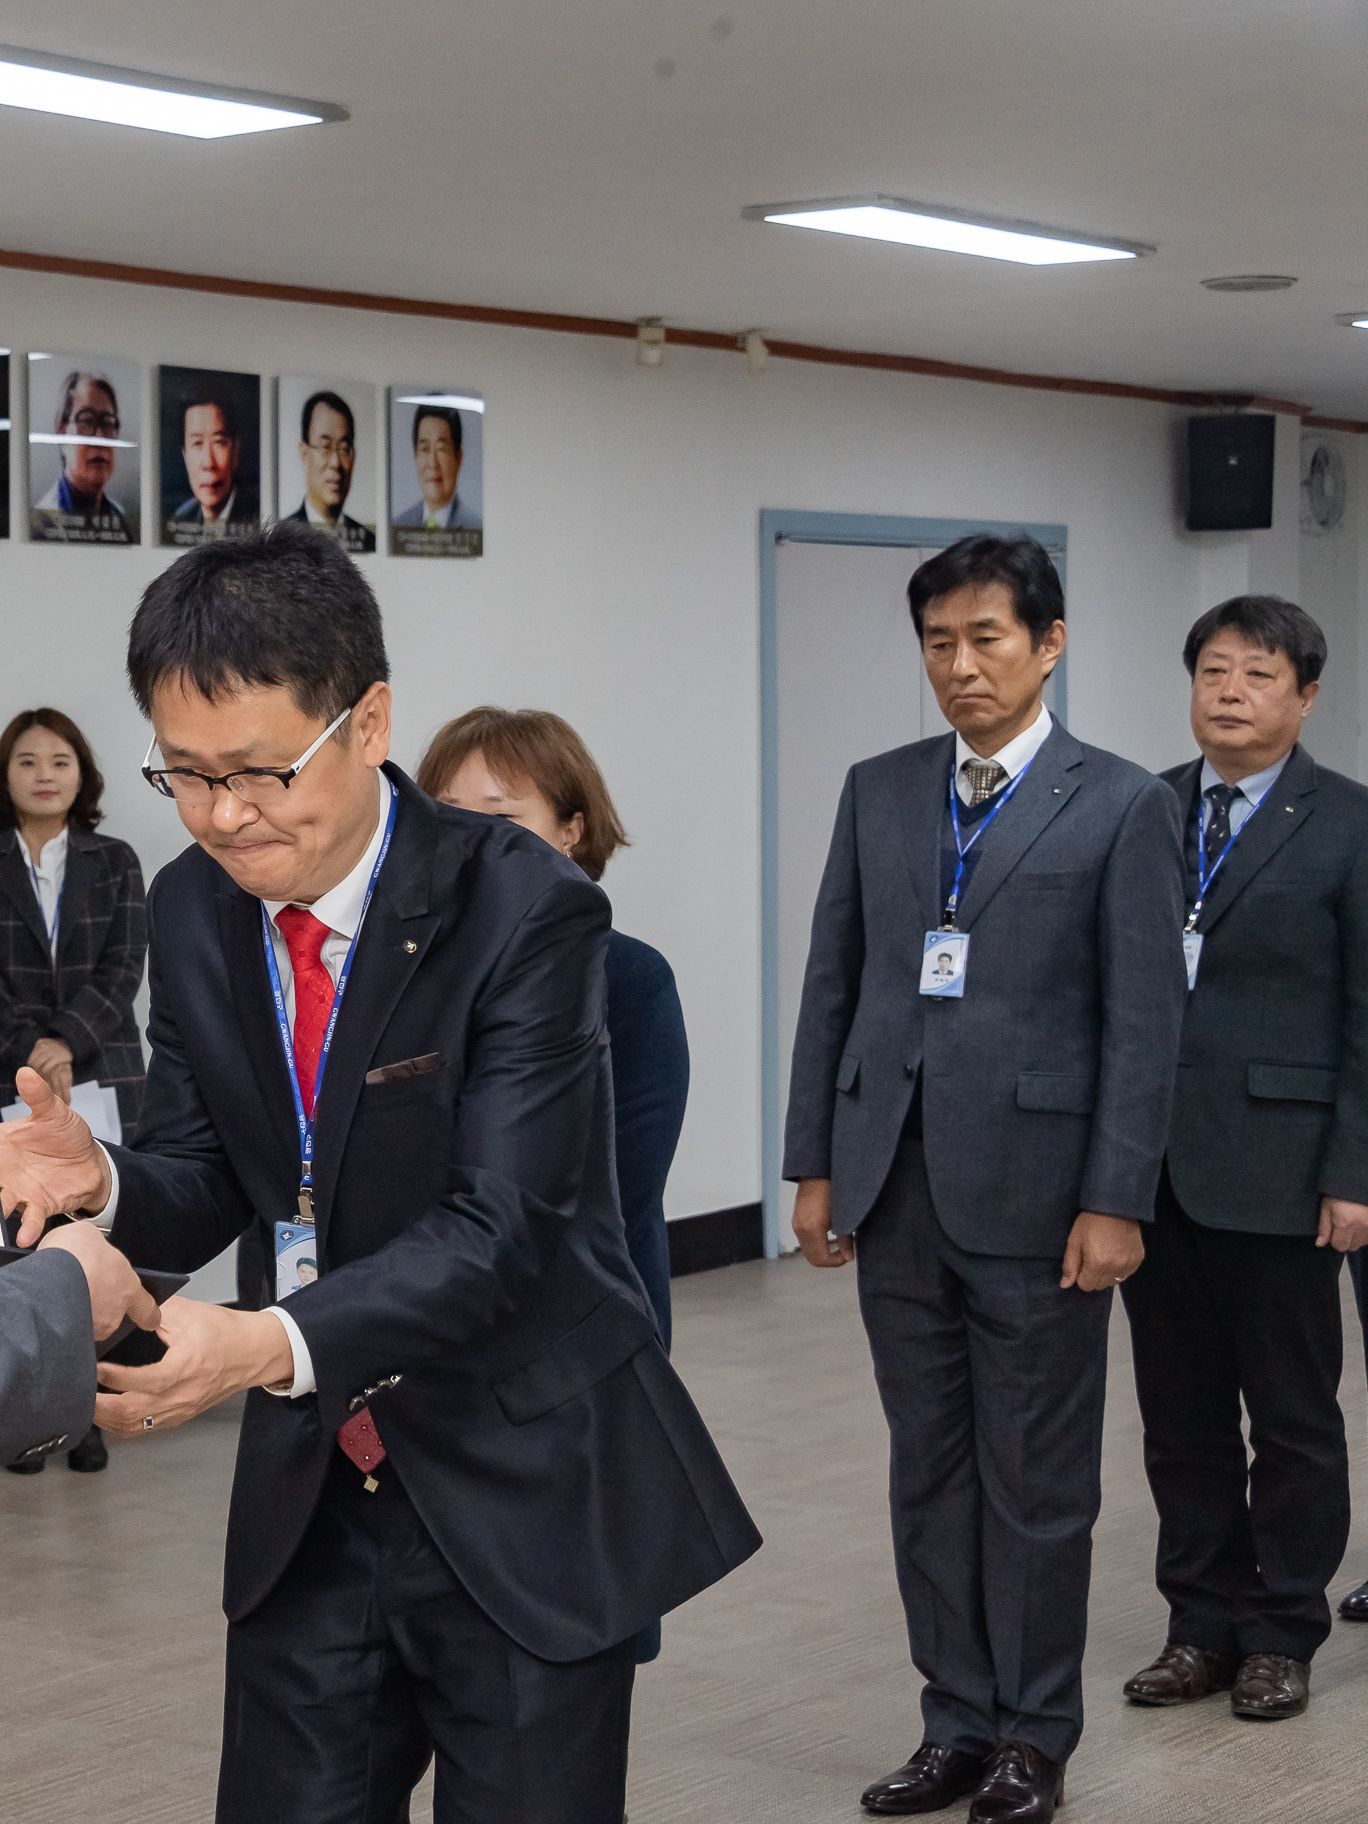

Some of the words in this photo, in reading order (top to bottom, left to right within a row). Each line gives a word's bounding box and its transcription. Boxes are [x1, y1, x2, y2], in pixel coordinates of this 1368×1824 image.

[373, 832, 391, 878] GWANGJIN-GU
[280, 1023, 294, 1069] GWANGJIN-GU
[323, 1007, 339, 1053] GWANGJIN-GU
